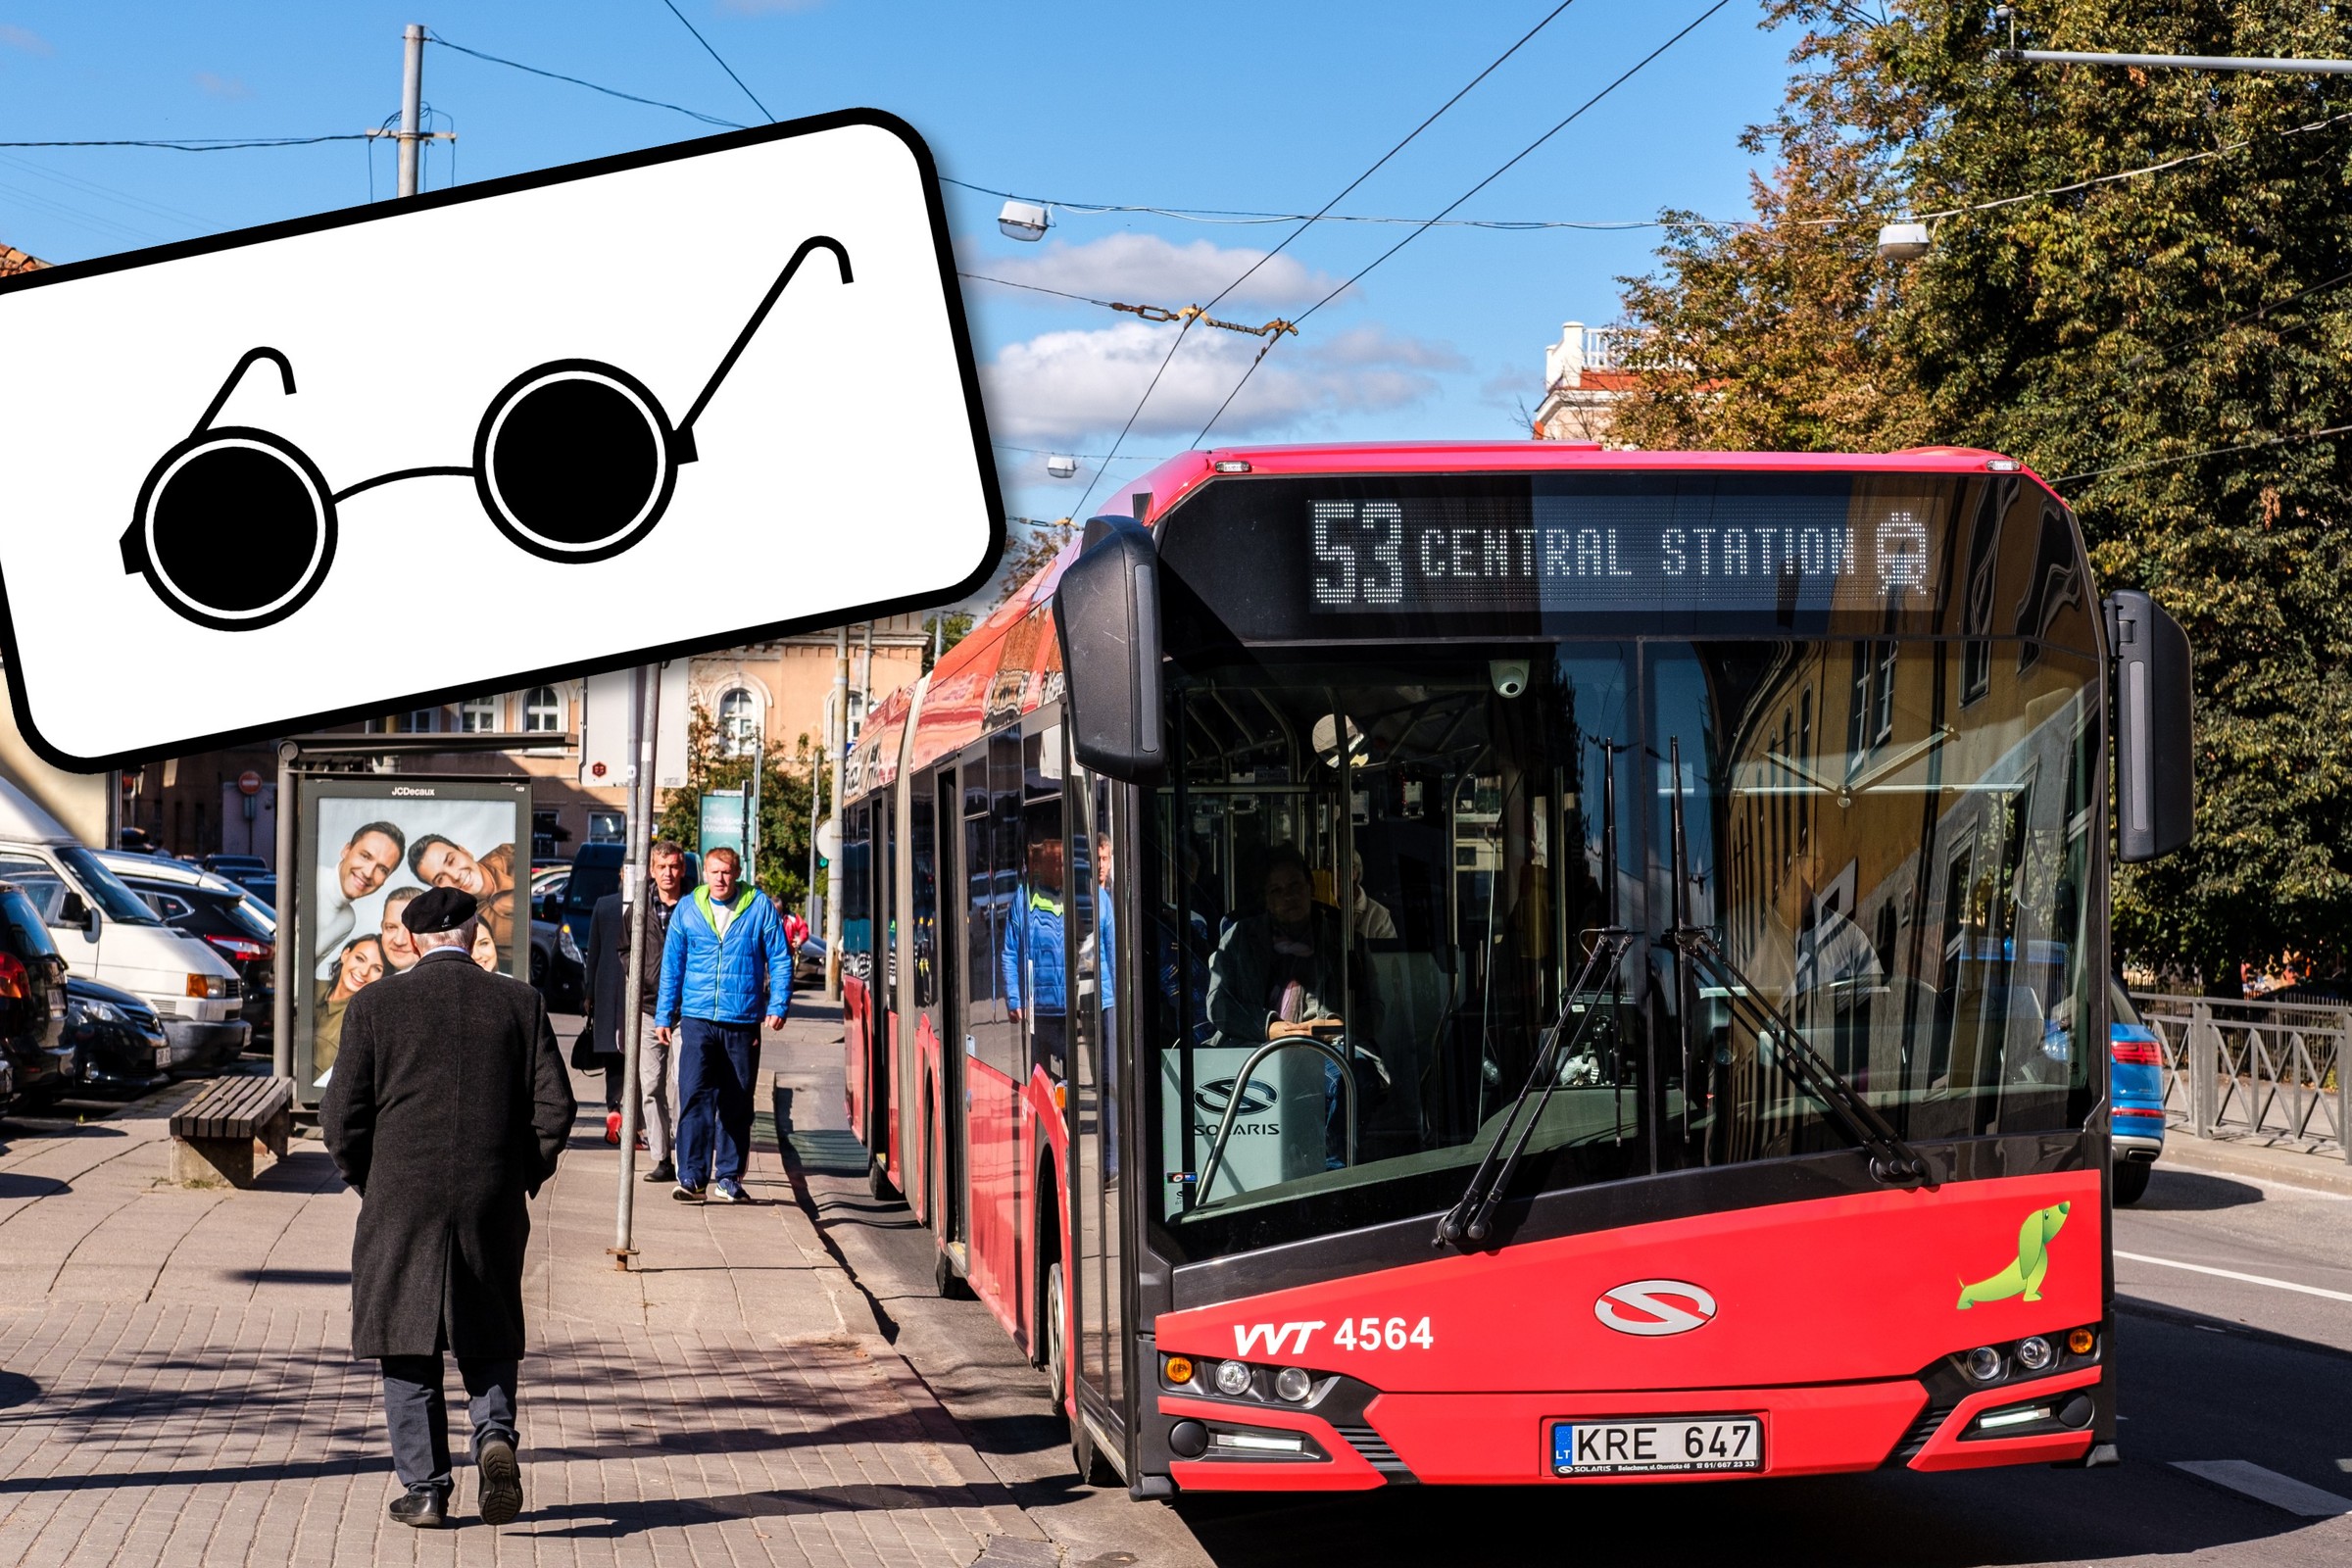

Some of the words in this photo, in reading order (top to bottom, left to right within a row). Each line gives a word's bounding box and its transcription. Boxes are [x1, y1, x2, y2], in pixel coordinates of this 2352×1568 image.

[1314, 503, 1402, 604] 53
[1420, 528, 1632, 576] CENTRAL
[1662, 527, 1855, 576] STATION
[391, 786, 435, 797] JCDecaux
[1194, 1123, 1280, 1136] SOARIS
[1333, 1316, 1434, 1351] 4564
[1555, 1449, 1571, 1460] LT
[1578, 1427, 1657, 1461] KRE
[1685, 1425, 1751, 1459] 647
